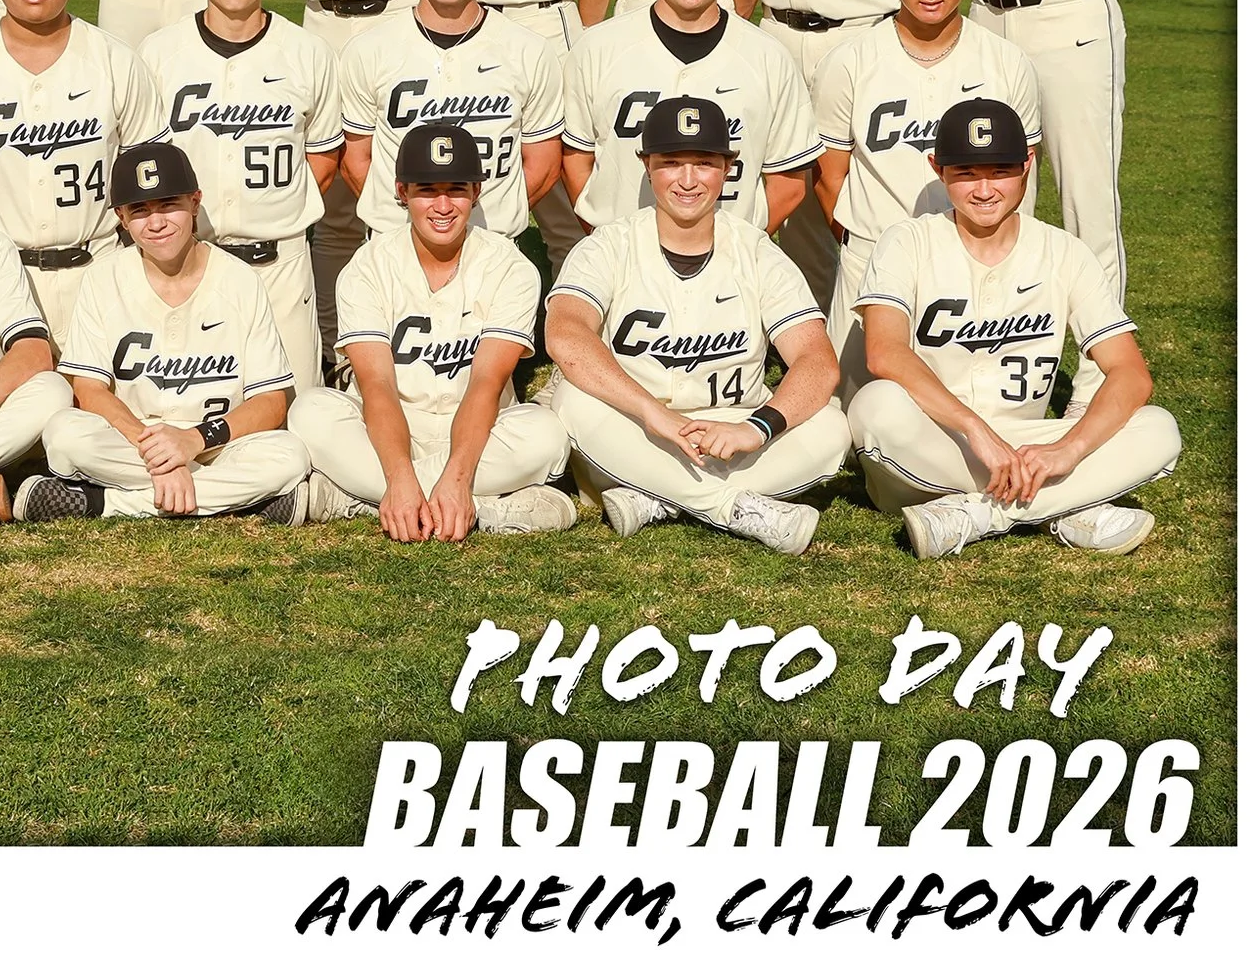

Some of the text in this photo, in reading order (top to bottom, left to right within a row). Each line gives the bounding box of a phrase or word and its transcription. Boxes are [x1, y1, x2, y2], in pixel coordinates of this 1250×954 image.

[170, 83, 294, 139] Canyon
[388, 80, 512, 128] Canyon
[677, 108, 699, 135] C
[430, 137, 452, 165] C
[968, 118, 992, 146] C
[54, 160, 105, 208] 34
[134, 160, 158, 189] C
[245, 145, 293, 188] 50
[612, 308, 748, 371] Canyon
[917, 299, 1054, 360] Canyon
[113, 333, 238, 394] Canyon
[1000, 357, 1060, 402] 33
[708, 367, 744, 407] 14
